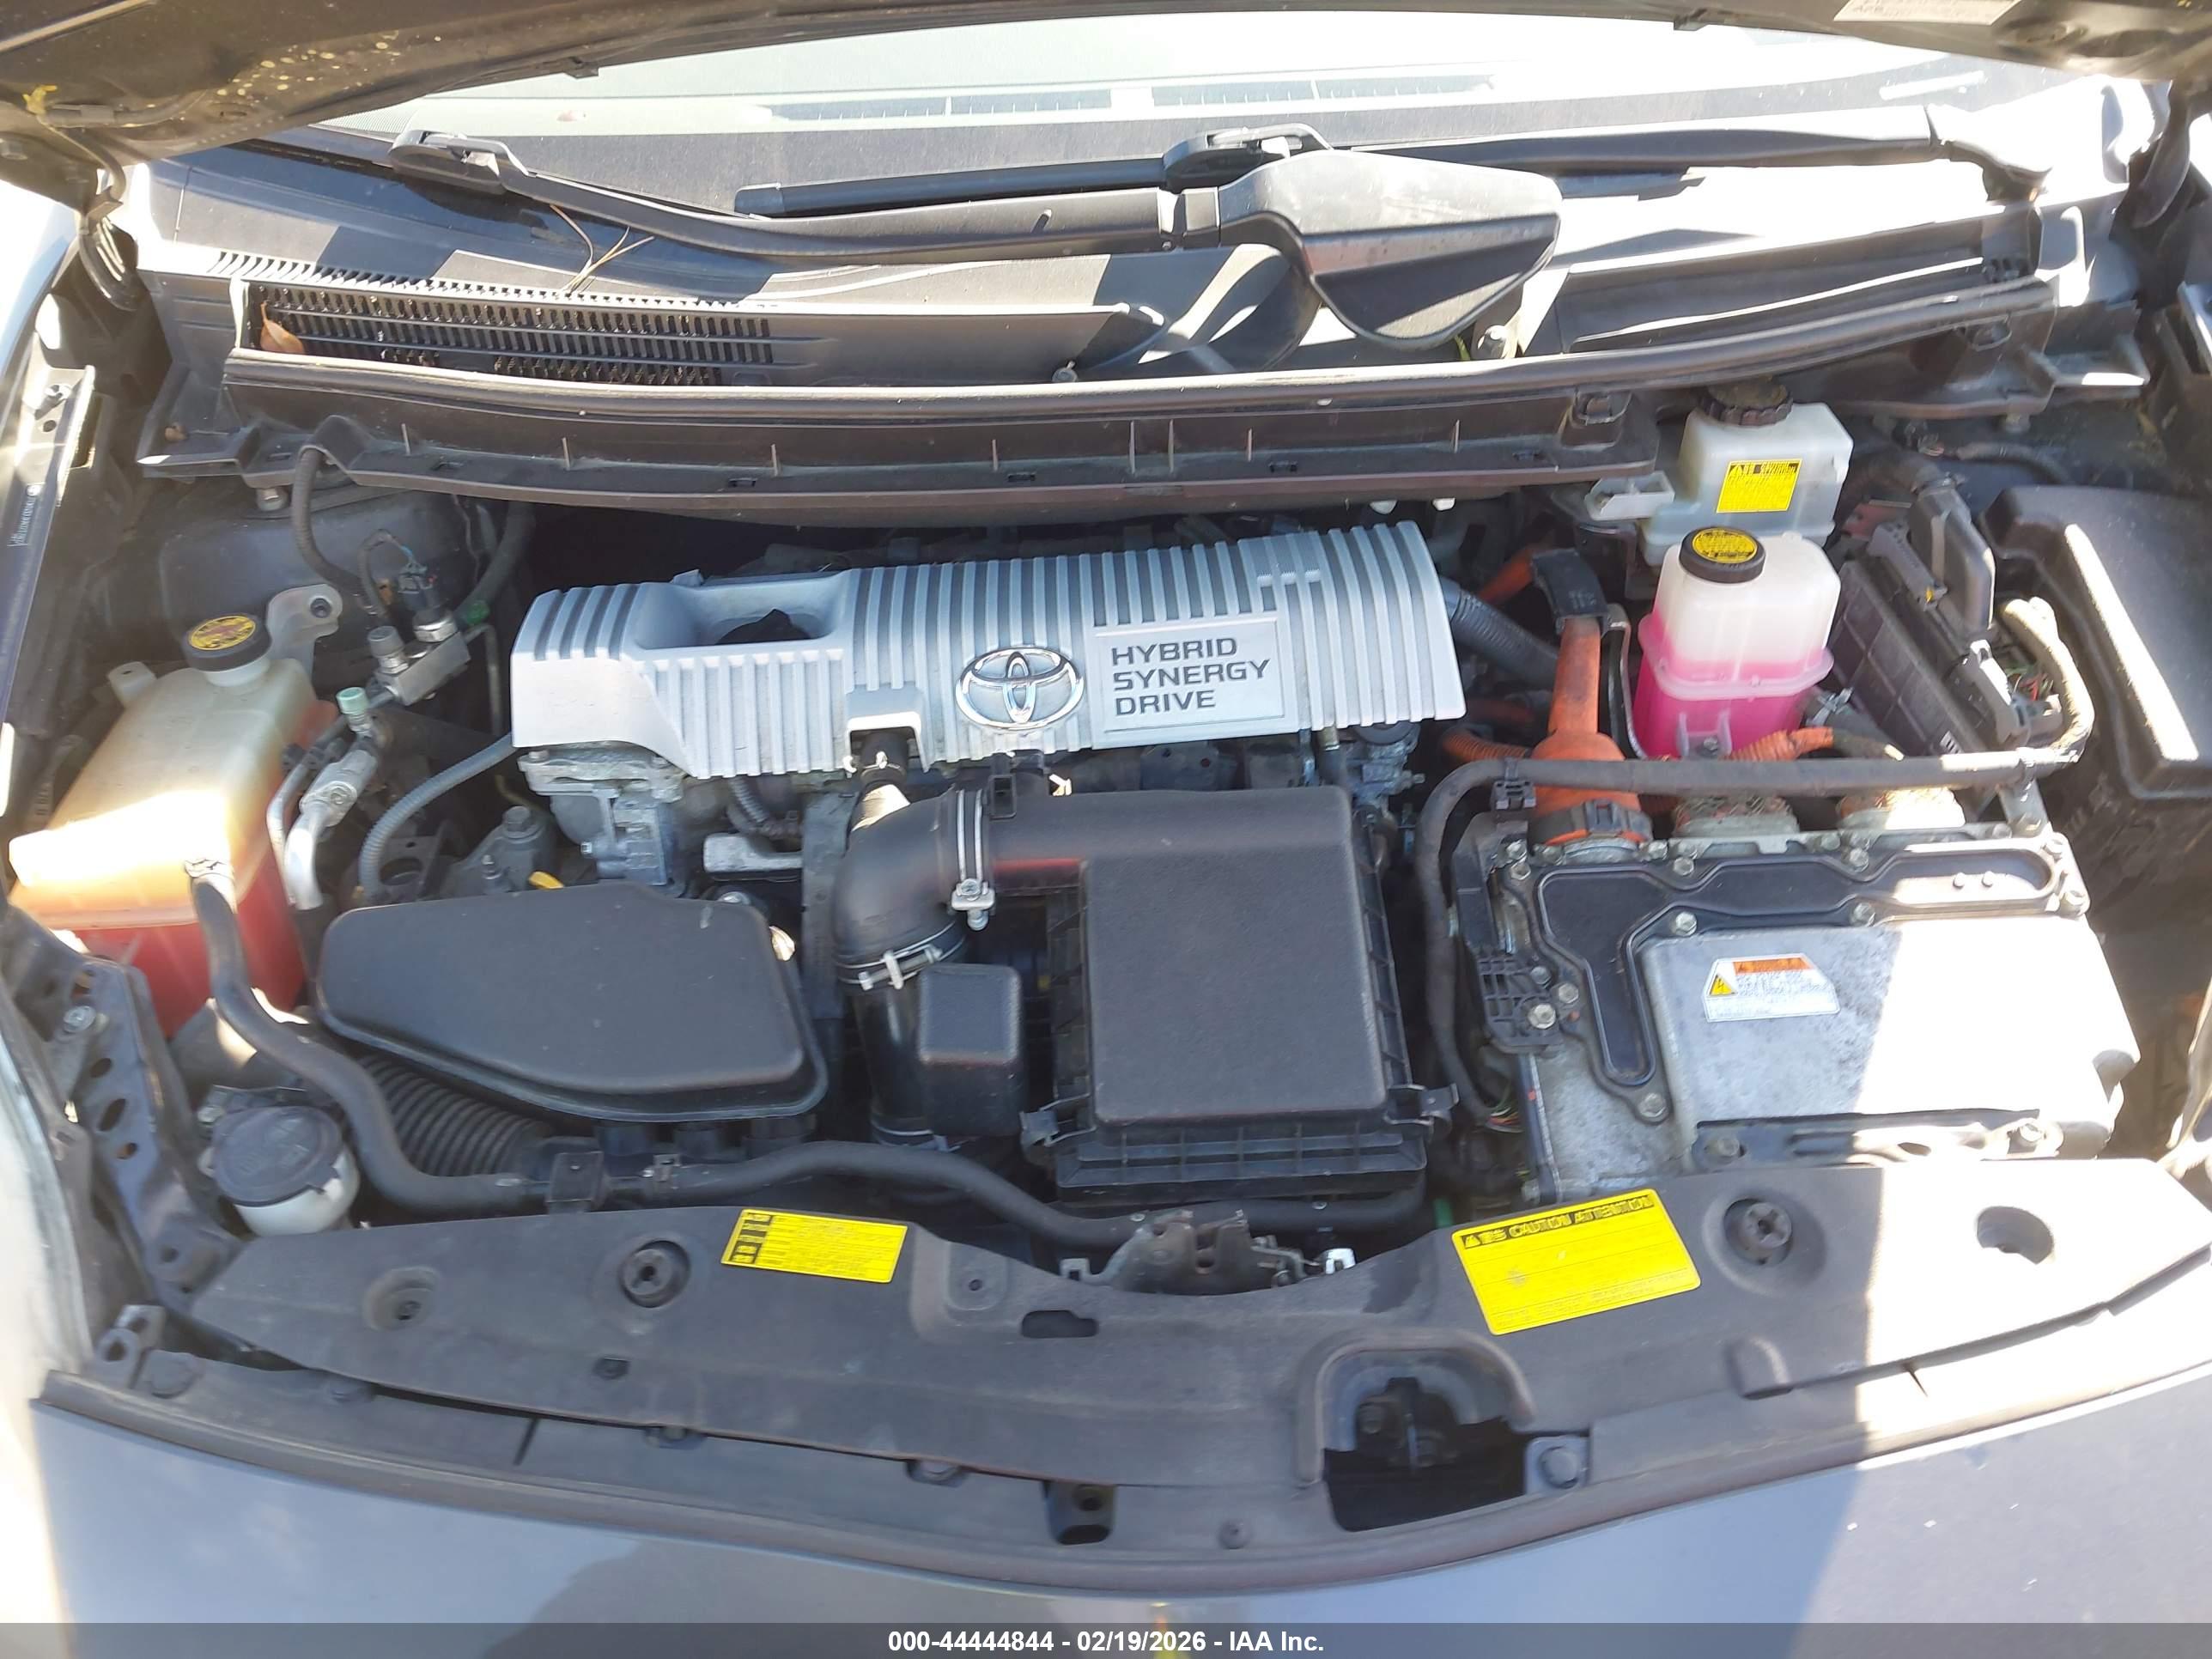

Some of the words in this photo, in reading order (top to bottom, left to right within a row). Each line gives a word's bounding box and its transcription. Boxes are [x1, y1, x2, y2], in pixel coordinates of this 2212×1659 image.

[1111, 637, 1237, 666] HYBRID
[1113, 659, 1271, 691] SYNERGY
[1115, 690, 1216, 716] DRIVE
[1508, 1213, 1572, 1237] CAUTION
[1574, 1194, 1655, 1224] ATTENTION
